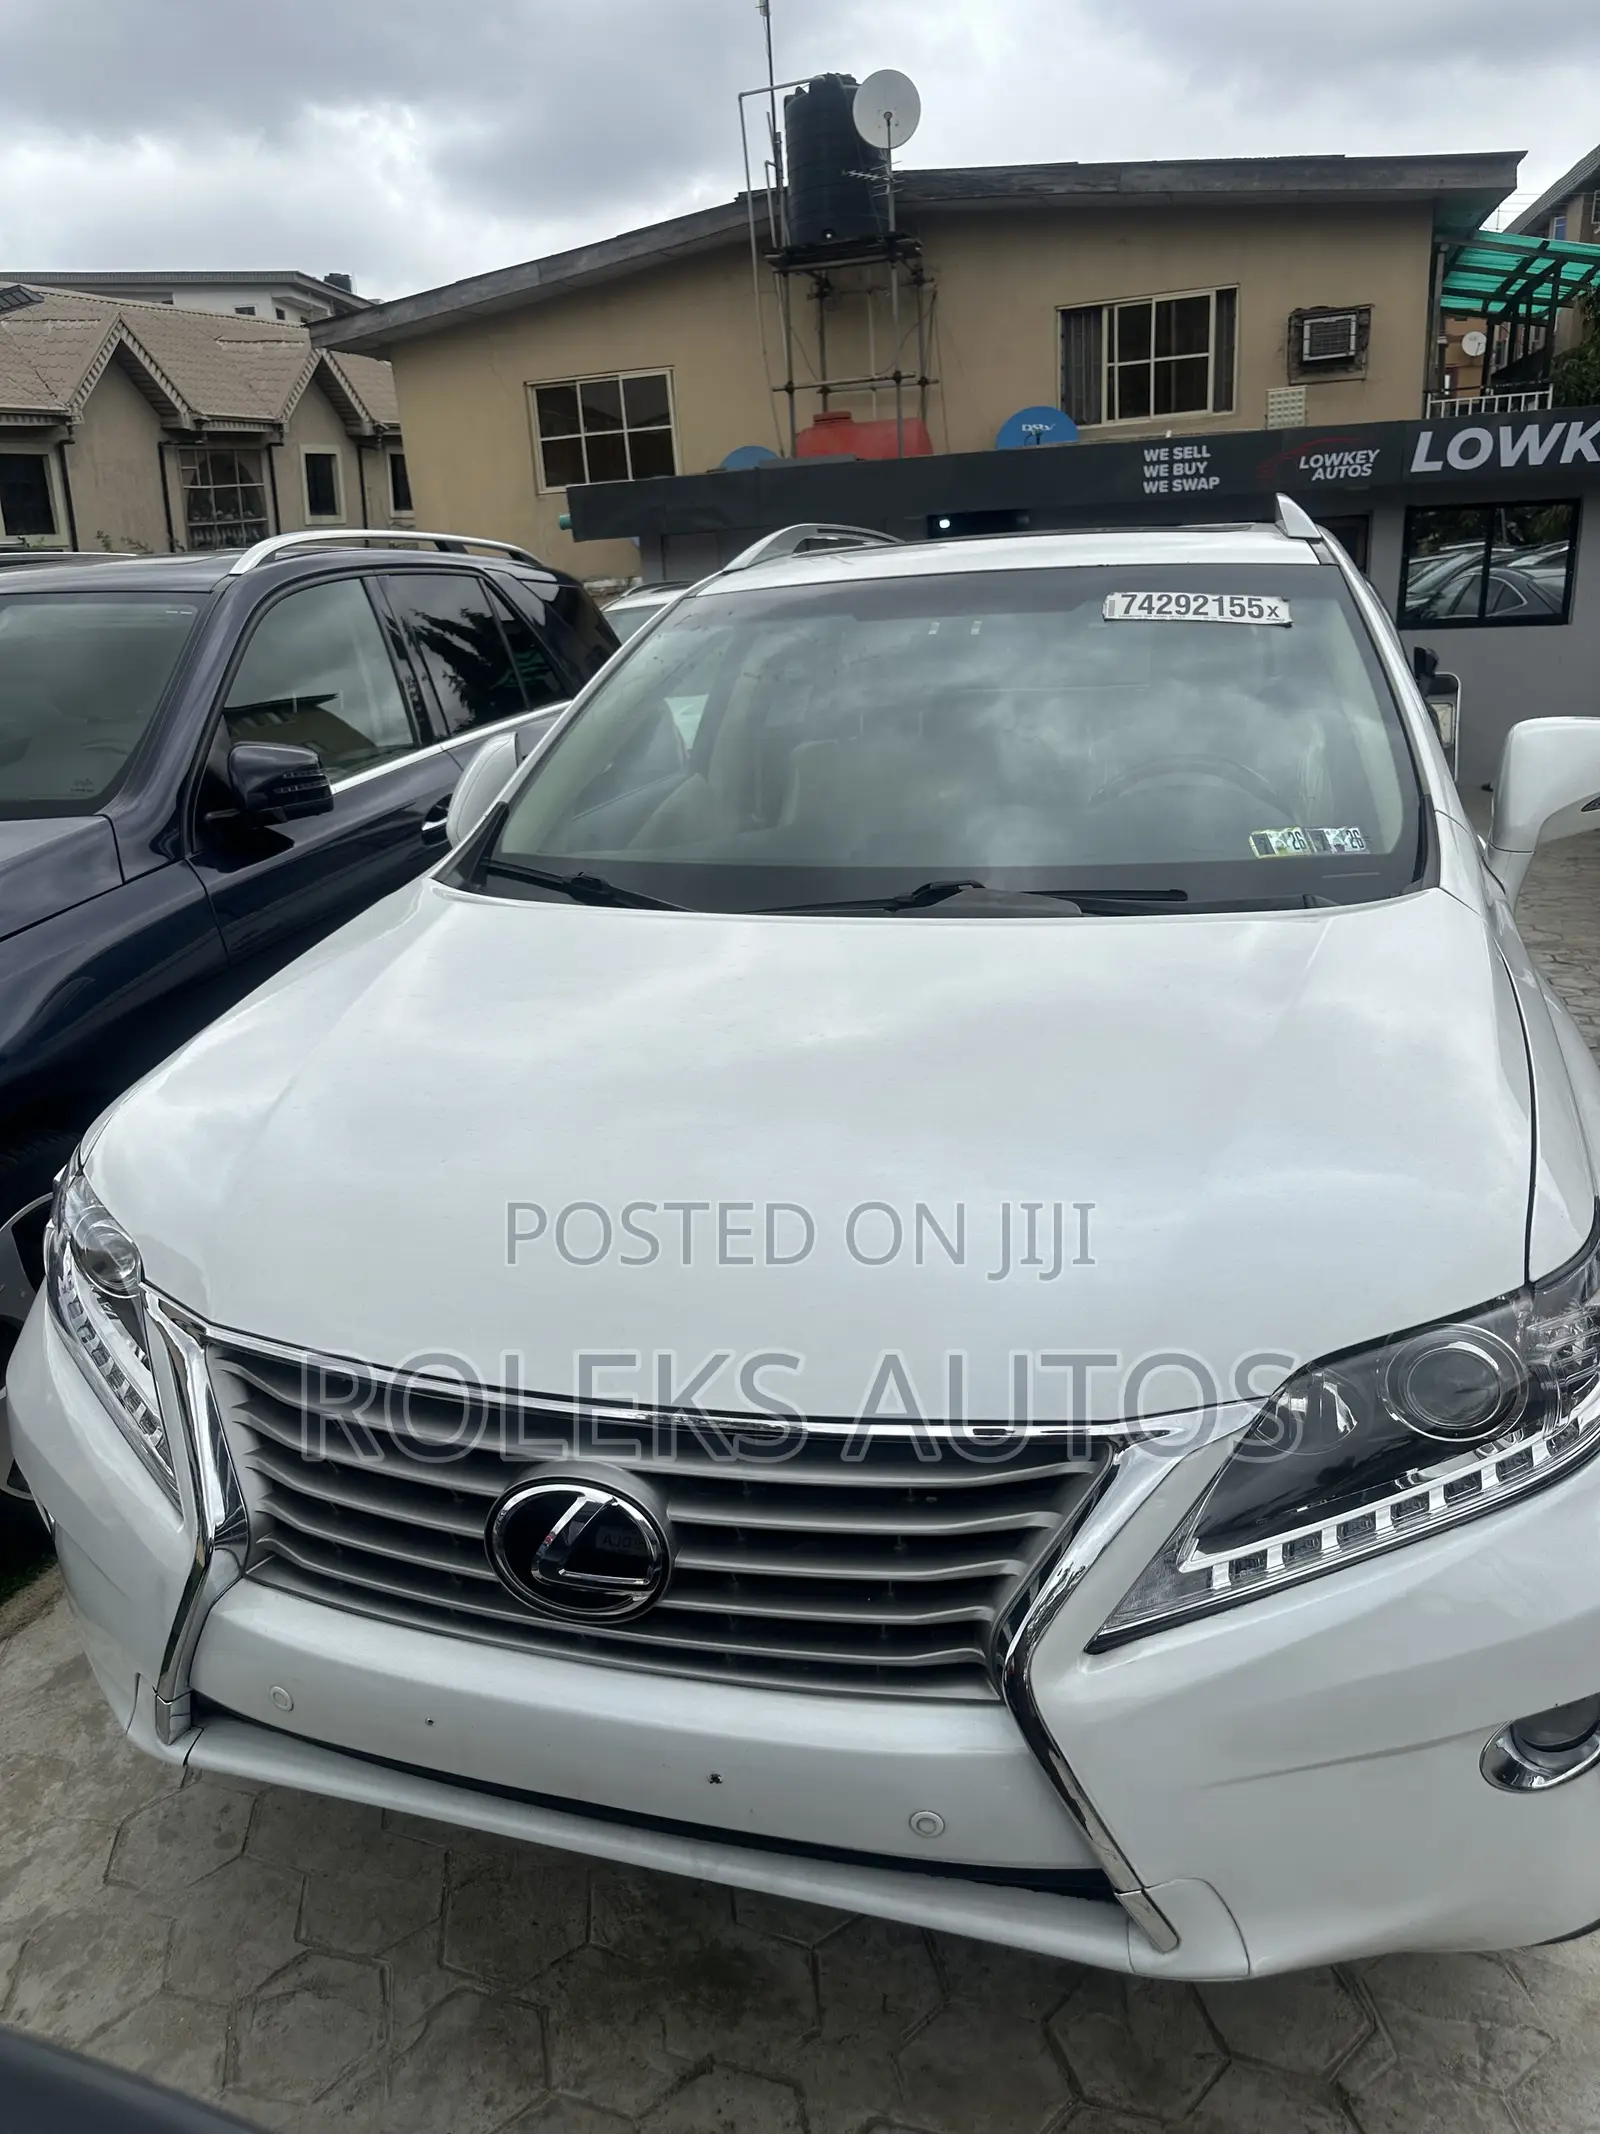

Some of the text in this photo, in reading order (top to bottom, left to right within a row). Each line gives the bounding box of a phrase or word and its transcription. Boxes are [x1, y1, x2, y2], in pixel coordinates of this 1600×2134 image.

[1143, 445, 1211, 462] WE SELL
[1299, 448, 1380, 469] LOWKEY
[1143, 461, 1208, 478] WE BUY
[1311, 463, 1372, 481] AUTOS
[1143, 476, 1220, 494] WE SWAP
[1288, 831, 1306, 850] 26
[1346, 829, 1364, 849] 26
